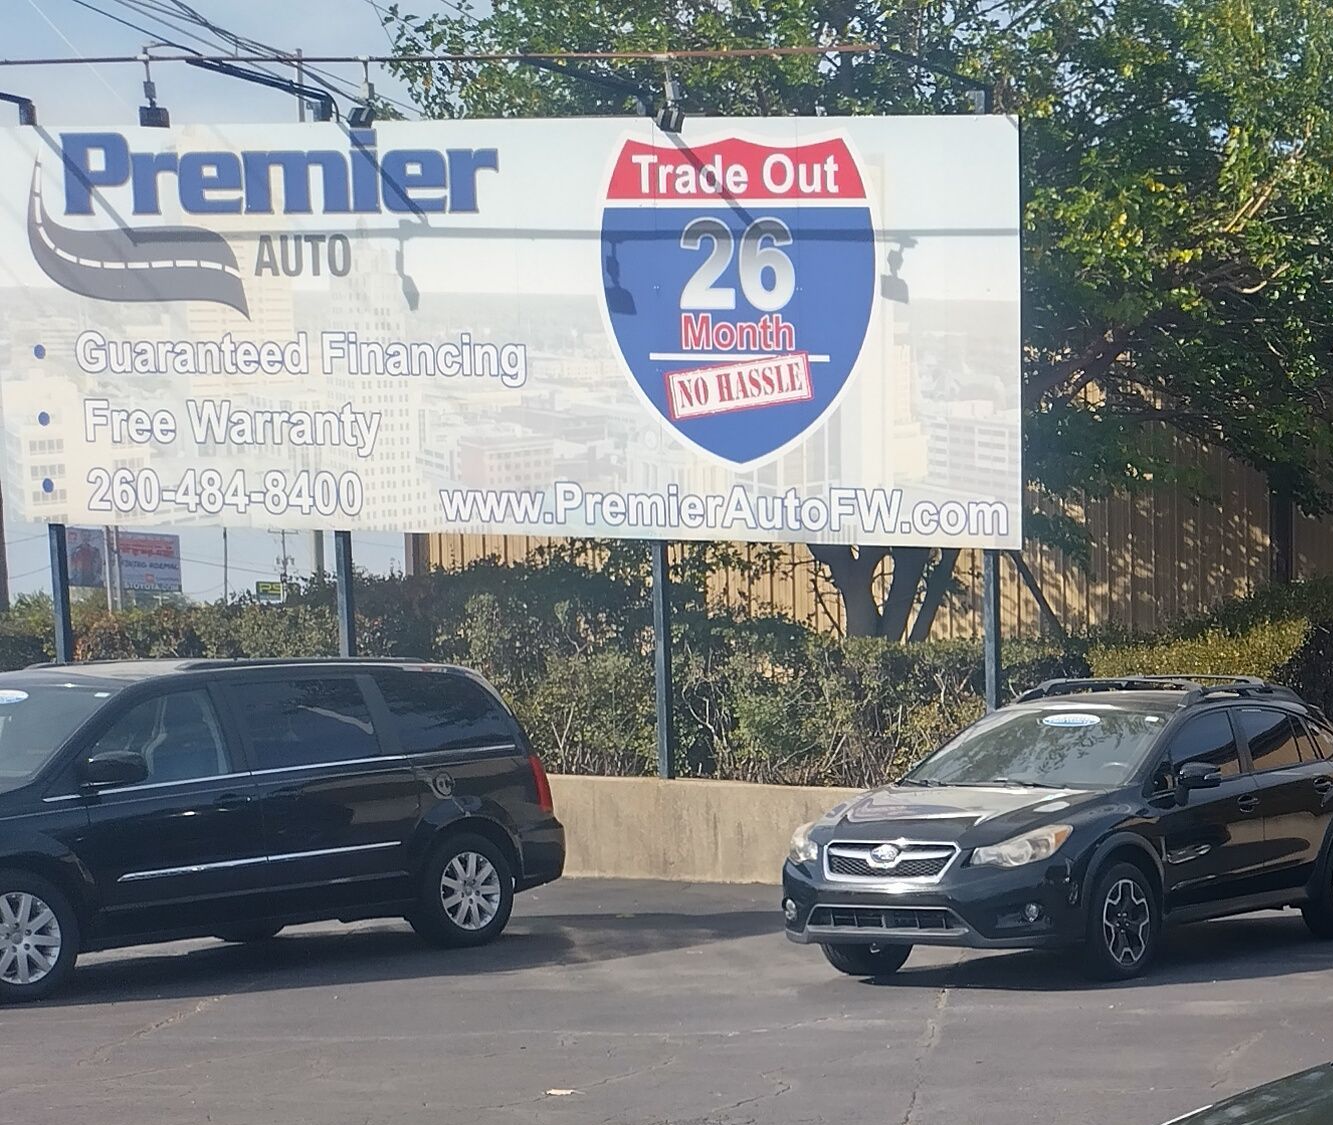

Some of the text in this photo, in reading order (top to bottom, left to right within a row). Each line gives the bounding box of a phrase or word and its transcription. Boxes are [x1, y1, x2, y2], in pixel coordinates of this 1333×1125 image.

[59, 128, 500, 216] Premier
[632, 153, 840, 195] Trade Out
[254, 234, 352, 278] AUTO
[679, 216, 796, 311] 26
[681, 313, 796, 352] Month
[74, 330, 528, 388] Guaranteed Financing
[676, 361, 805, 410] NO HASSLE
[83, 399, 383, 457] Free Warranty
[86, 467, 364, 517] 260-484-8400
[439, 481, 1010, 536] www.PremierAutoFW.com
